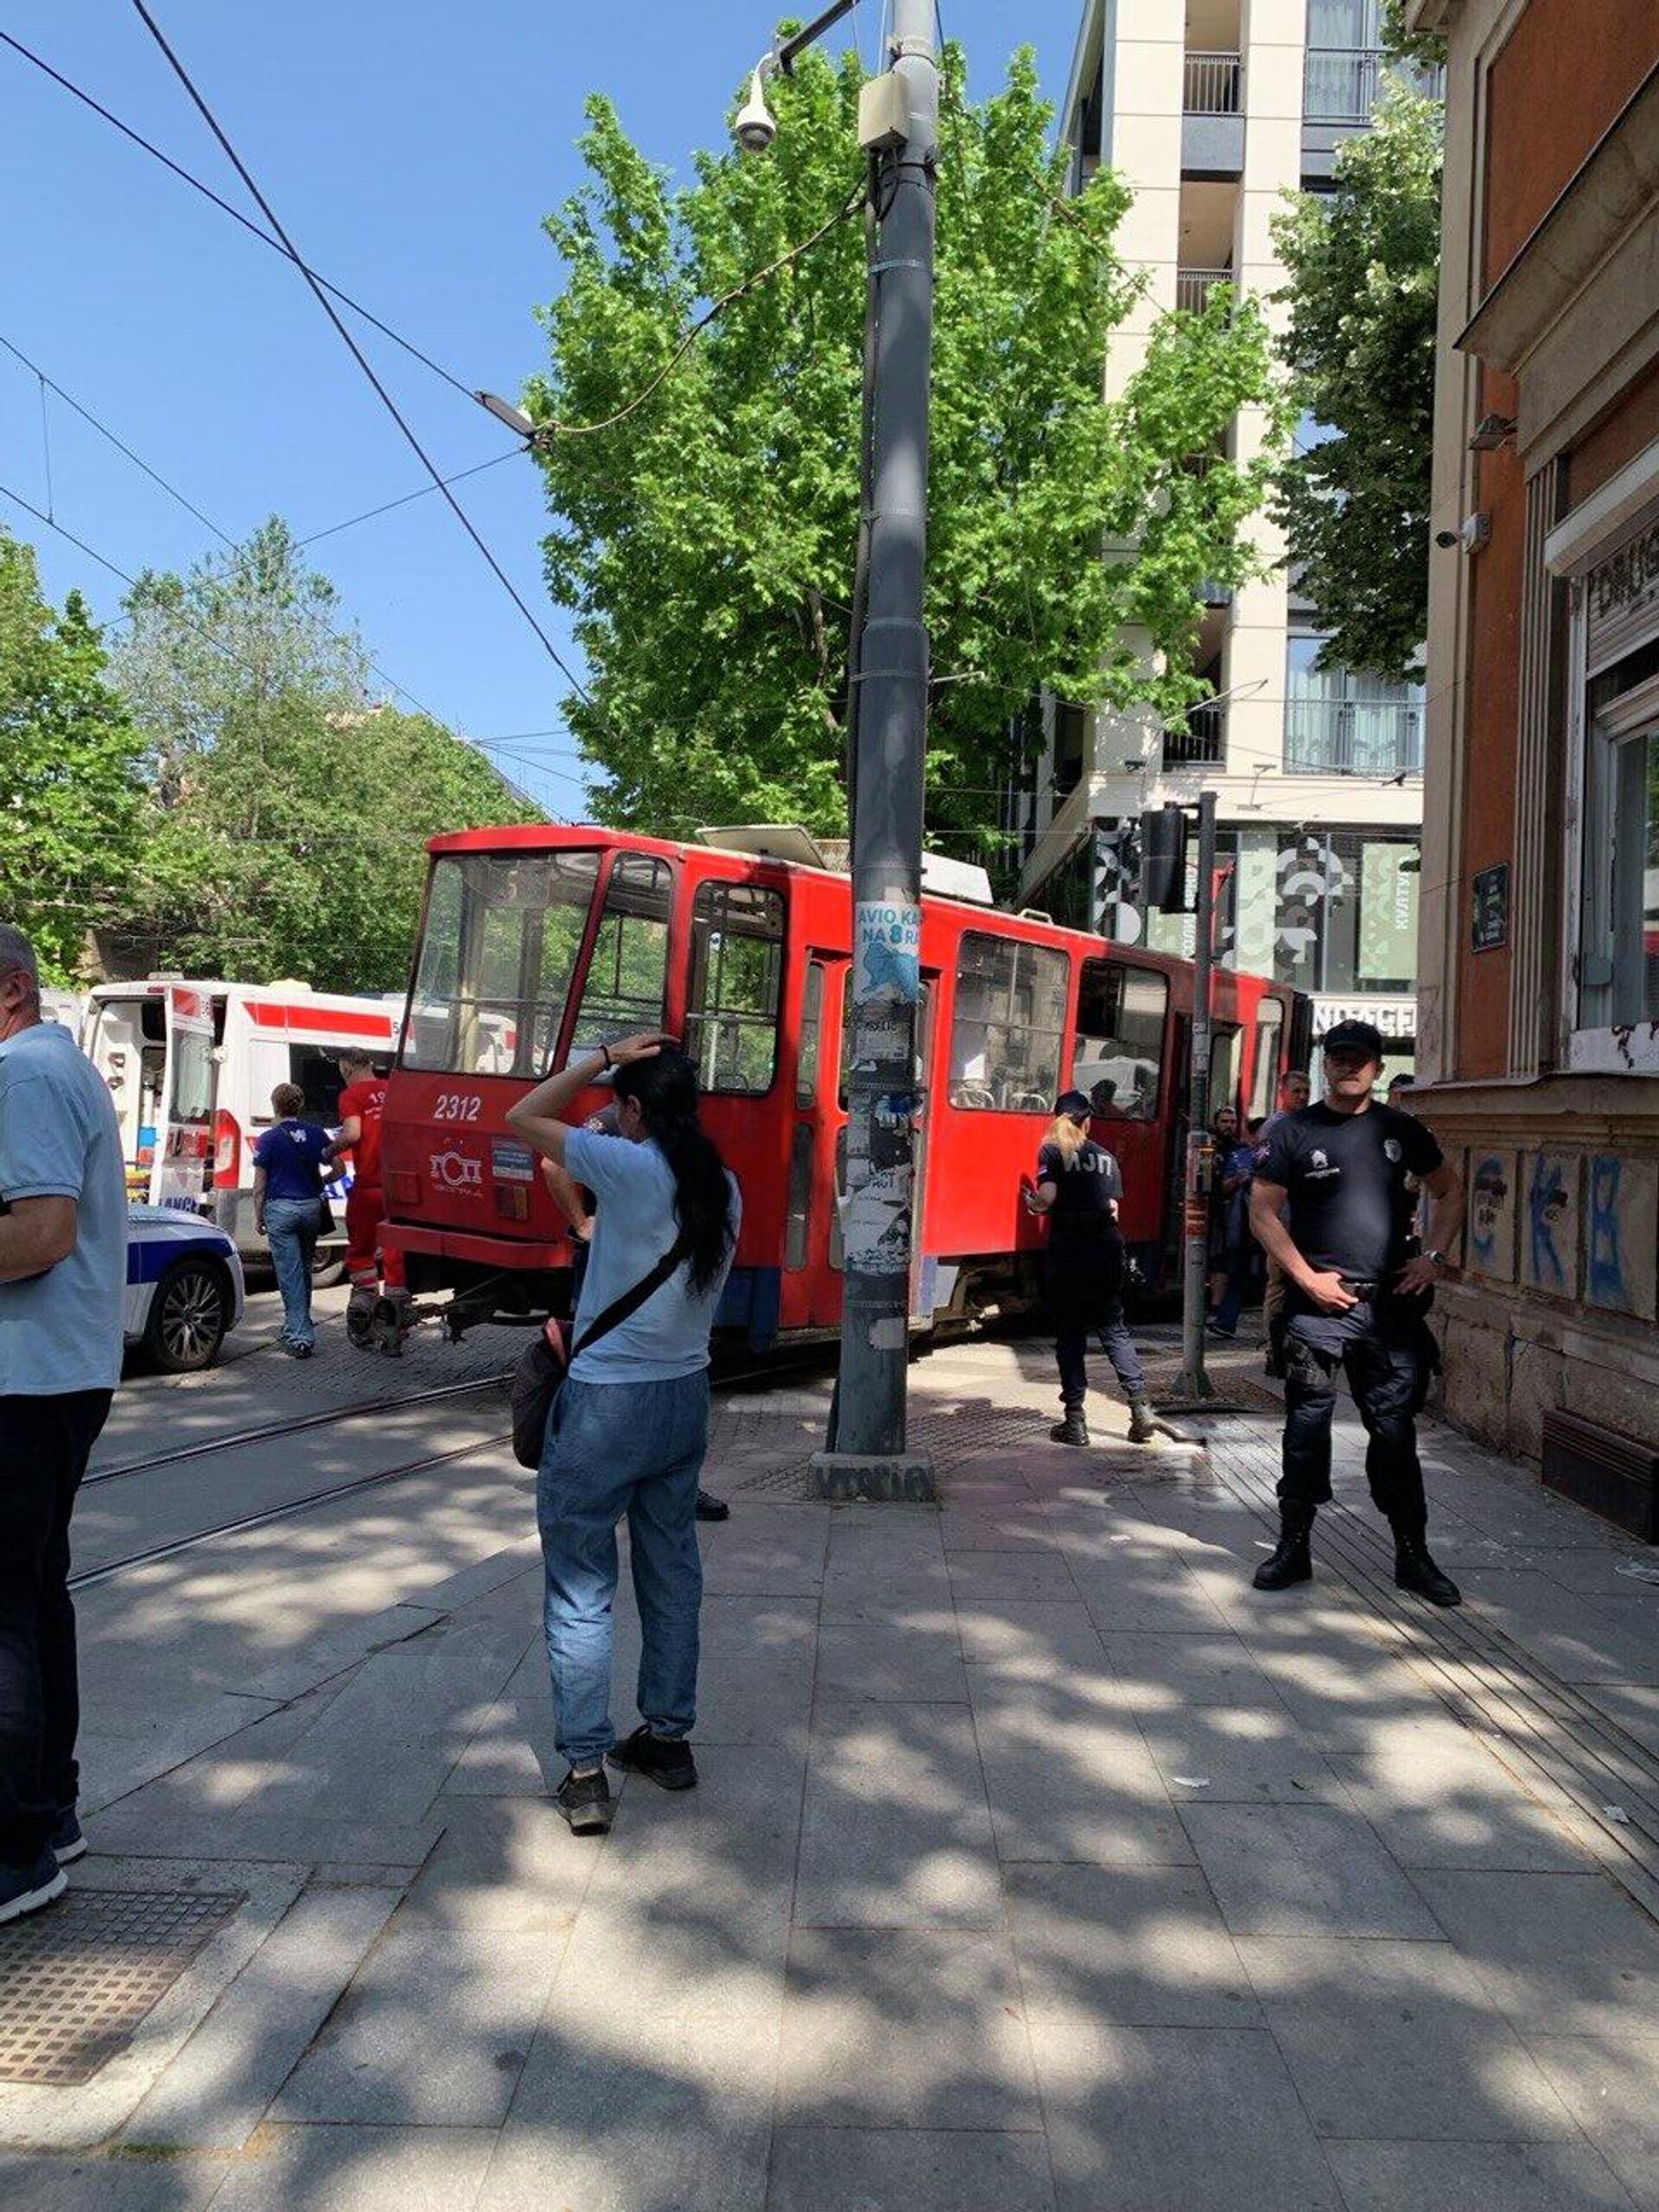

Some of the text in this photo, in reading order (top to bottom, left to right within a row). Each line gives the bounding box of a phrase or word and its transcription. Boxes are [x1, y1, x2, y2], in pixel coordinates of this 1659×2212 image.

[858, 908, 921, 925] AVIO KA
[862, 928, 885, 944] NA
[889, 924, 903, 944] 8
[434, 1094, 481, 1122] 2312
